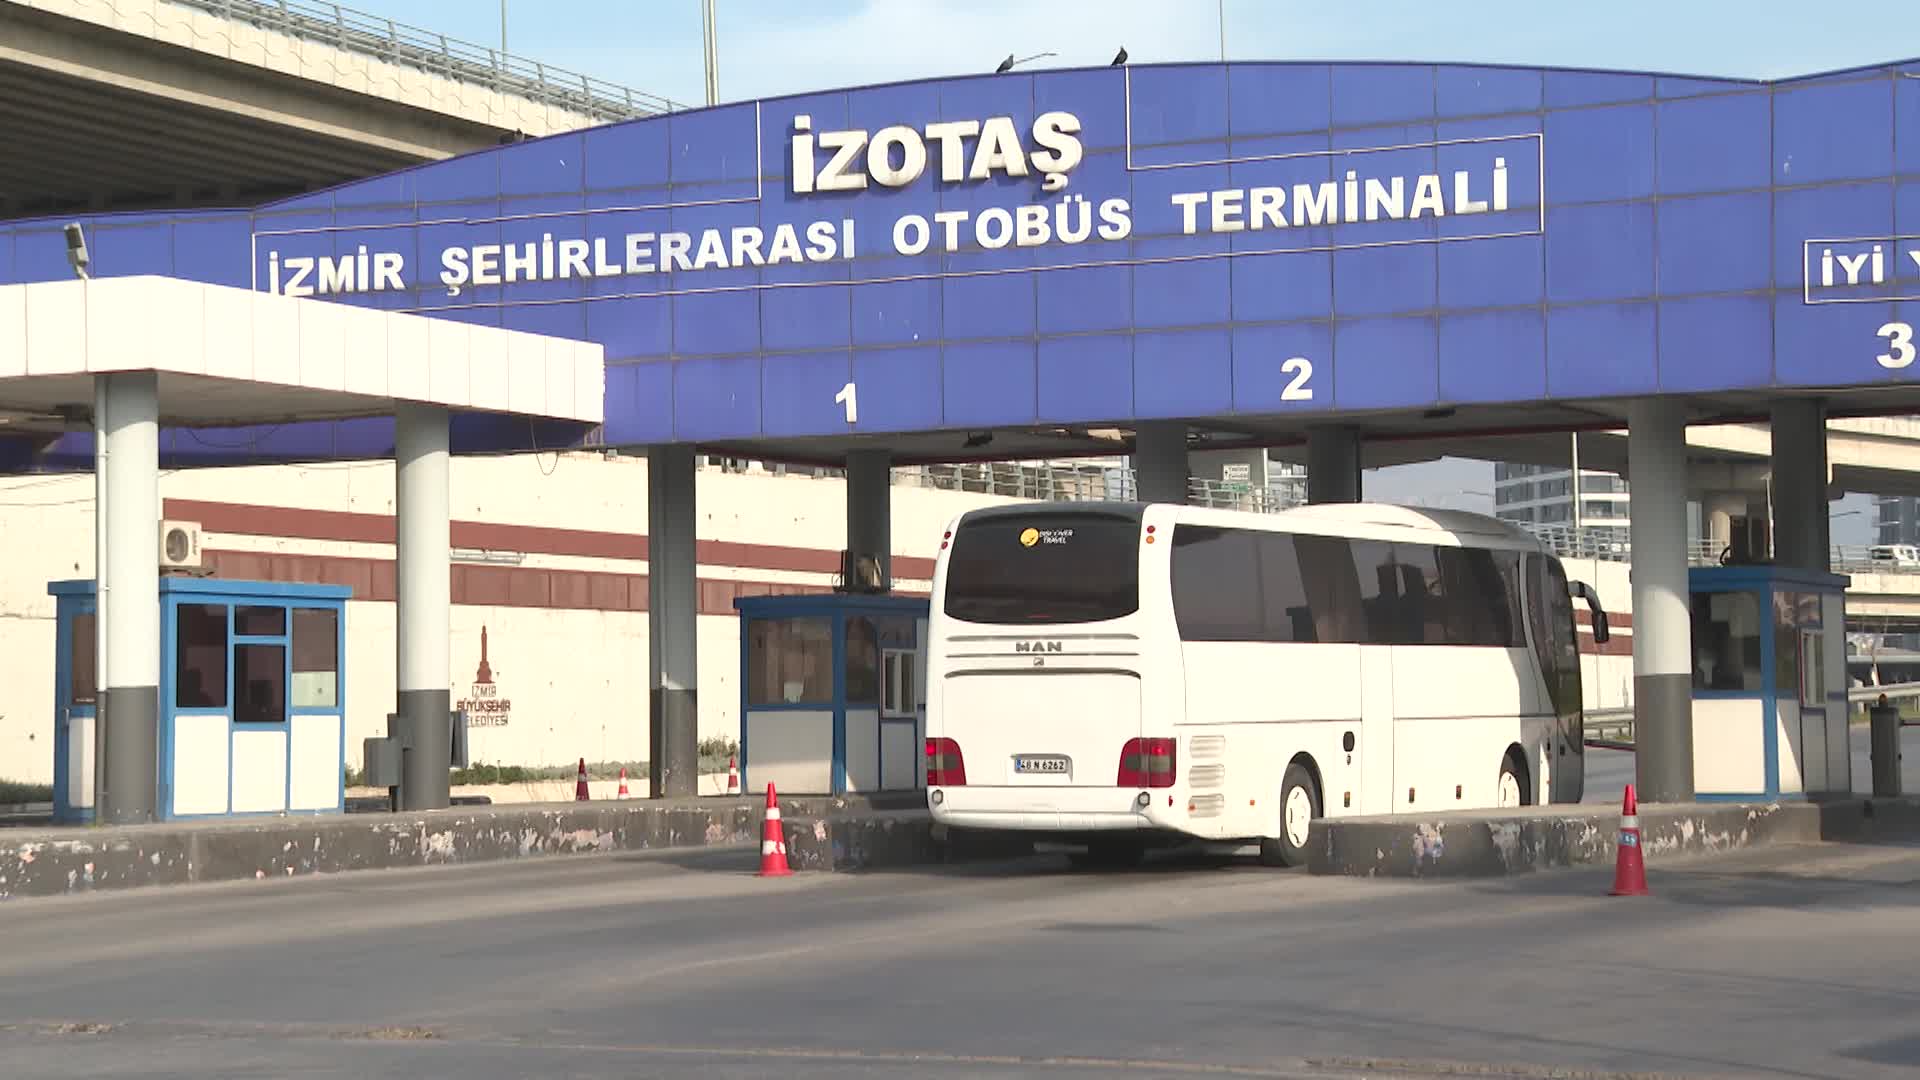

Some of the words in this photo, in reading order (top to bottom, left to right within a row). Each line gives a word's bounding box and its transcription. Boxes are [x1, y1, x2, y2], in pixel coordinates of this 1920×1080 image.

[791, 111, 1084, 192] İZOTAŞ
[268, 244, 405, 298] İZMİR
[440, 218, 855, 297] ŞEHİRLERARASI
[893, 195, 1132, 256] OTOBÜS
[1171, 157, 1508, 235] TERMİNALİ
[1821, 245, 1884, 287] İYİ
[1875, 322, 1917, 368] 3
[1280, 358, 1314, 401] 2
[835, 382, 857, 423] 1
[1015, 641, 1062, 652] MAN
